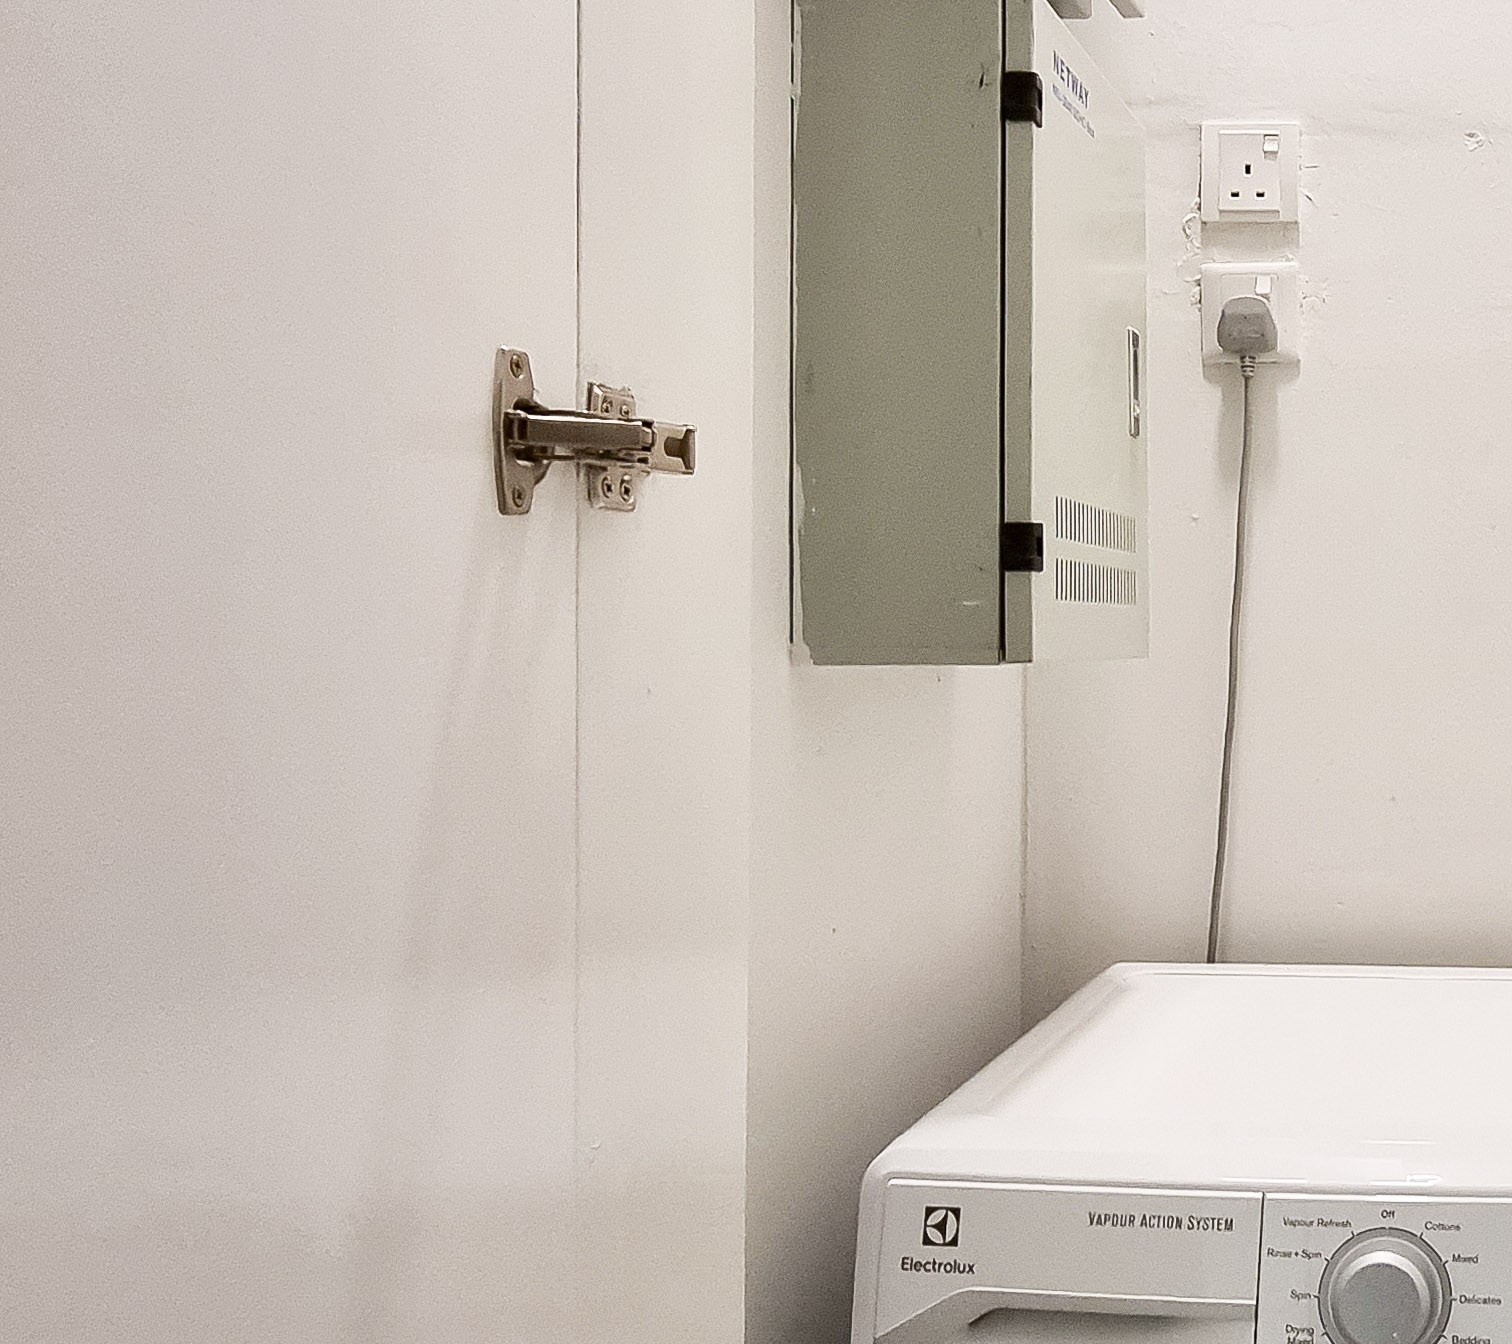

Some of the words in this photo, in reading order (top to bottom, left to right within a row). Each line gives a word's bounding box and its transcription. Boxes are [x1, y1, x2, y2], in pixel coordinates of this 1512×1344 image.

[1053, 49, 1089, 109] NETWAY
[1380, 1209, 1396, 1220] Off
[1088, 1211, 1136, 1229] VAPOUR
[1140, 1213, 1184, 1231] ACTION
[1187, 1214, 1235, 1232] SYSTEM
[1282, 1216, 1315, 1229] Vapour
[1316, 1218, 1352, 1228] Refresh
[1424, 1221, 1461, 1232] Cottons
[1266, 1247, 1292, 1258] Rinse
[1301, 1248, 1322, 1260] Spin
[1452, 1254, 1479, 1264] Mixed
[900, 1256, 976, 1275] Electrolux
[1290, 1289, 1312, 1301] Spin
[1459, 1294, 1502, 1305] Delicates
[1285, 1324, 1315, 1336] Drying
